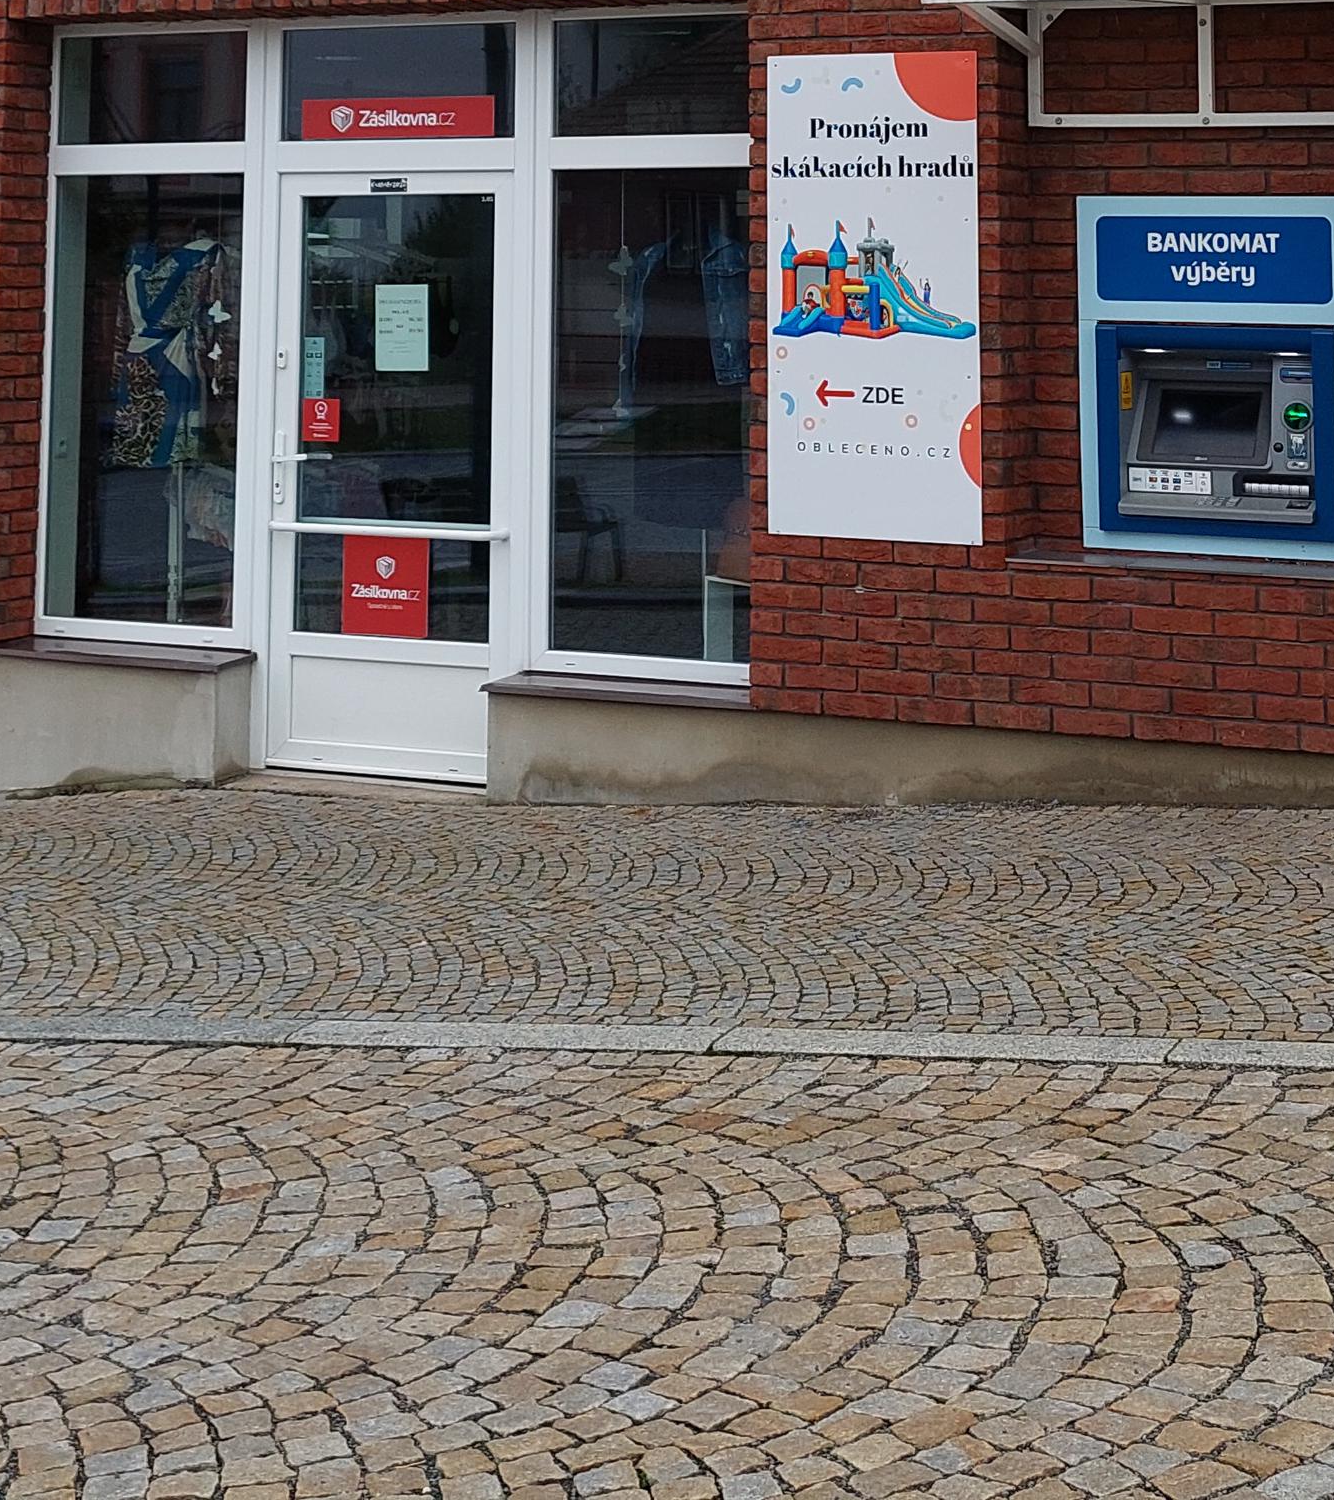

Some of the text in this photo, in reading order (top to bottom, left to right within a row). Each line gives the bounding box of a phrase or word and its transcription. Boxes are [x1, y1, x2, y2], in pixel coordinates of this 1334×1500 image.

[358, 109, 456, 127] Zásilkovna.cz
[808, 116, 929, 145] Pronájem
[771, 155, 974, 178] skákacích hradů
[1146, 231, 1280, 254] BANKOMAT
[1170, 260, 1256, 287] výběry
[862, 386, 905, 405] ZDE
[797, 441, 951, 458] OBLECENO.CZ
